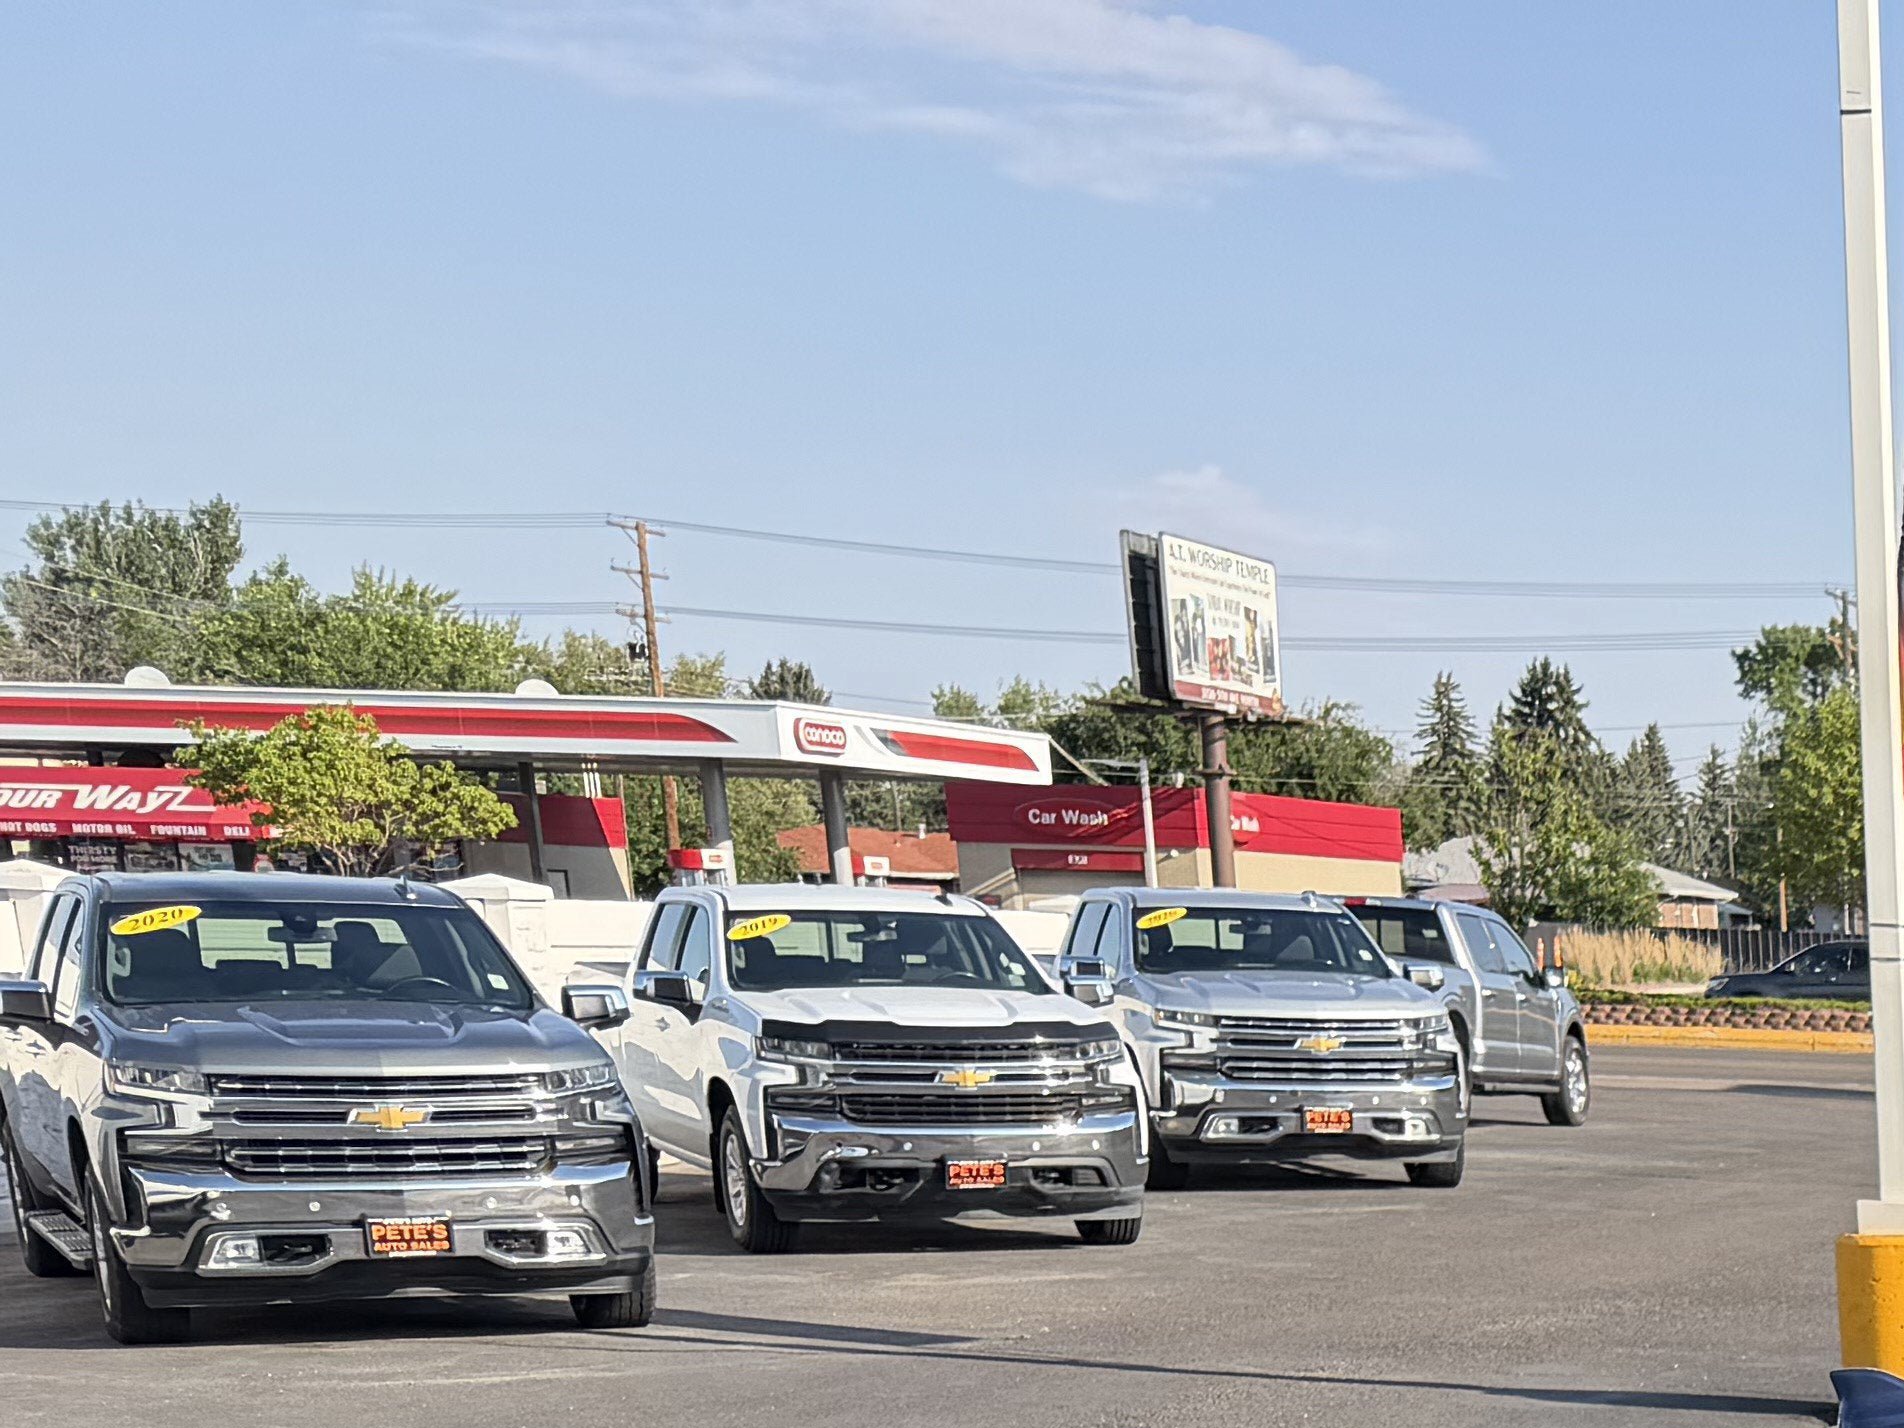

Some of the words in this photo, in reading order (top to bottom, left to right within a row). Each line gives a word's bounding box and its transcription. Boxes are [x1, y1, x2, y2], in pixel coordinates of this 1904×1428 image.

[1188, 547, 1232, 573] WORSHIP
[1236, 560, 1270, 584] TEMPLE
[1028, 808, 1056, 825] Car
[1062, 809, 1110, 826] Wash
[25, 822, 57, 833] DOGS
[72, 823, 113, 834] MOTOR
[116, 823, 136, 835] OIL
[150, 825, 206, 836] FOUNTAIN
[224, 825, 250, 836] DELI
[129, 908, 183, 931] 2020
[741, 917, 778, 936] 2019
[950, 1163, 1005, 1177] PETE'S
[371, 1223, 448, 1240] PETE'S
[374, 1241, 408, 1252] AUTO
[410, 1240, 450, 1251] SALES
